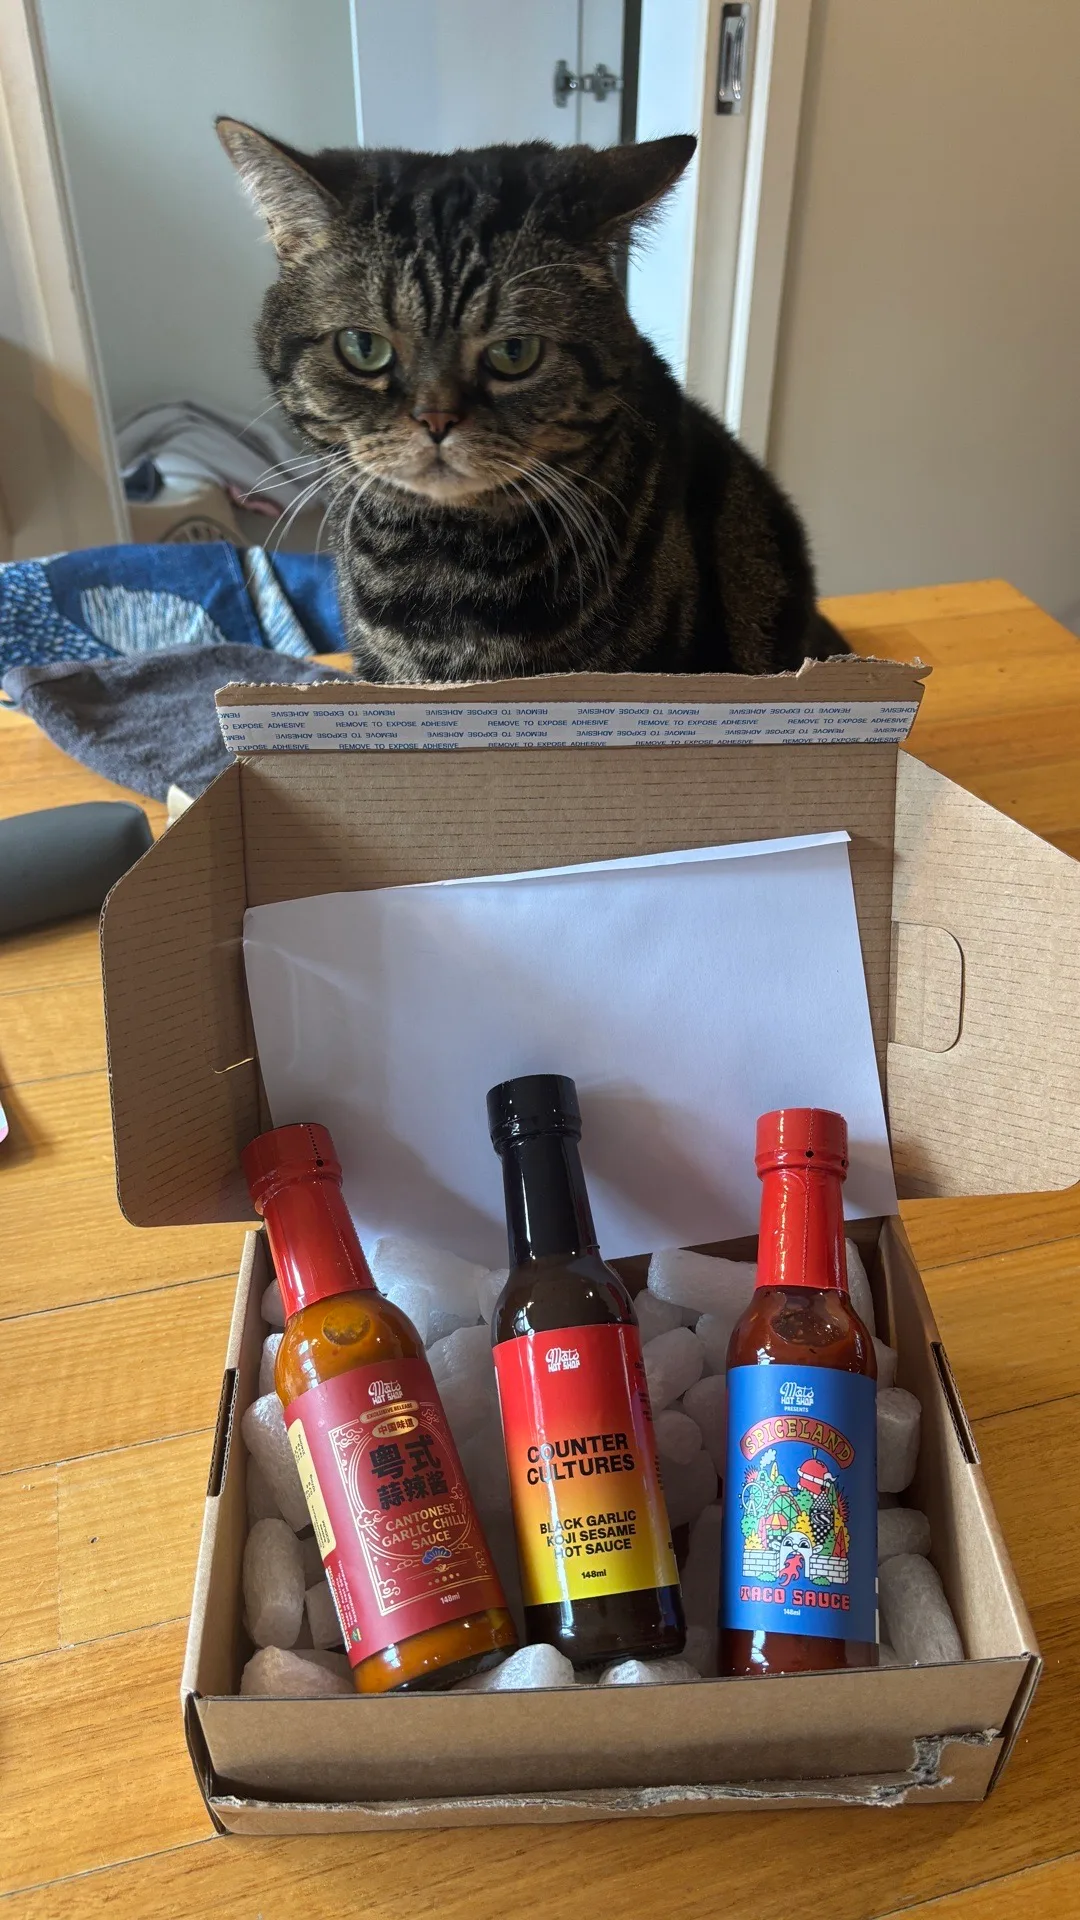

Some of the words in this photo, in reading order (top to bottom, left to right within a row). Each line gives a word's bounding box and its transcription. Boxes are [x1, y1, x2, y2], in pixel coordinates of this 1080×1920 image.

[548, 1363, 561, 1372] HOT
[563, 1360, 580, 1370] SHOP
[372, 1394, 386, 1405] HOT
[386, 1390, 403, 1400] SHOP
[796, 1398, 814, 1406] SHOP
[366, 1407, 393, 1419] EXCLUSIVE
[394, 1403, 412, 1411] RELEASE
[378, 1418, 414, 1434] 中国味道
[527, 1433, 628, 1464] COUNTER
[744, 1418, 851, 1461] SPICELAND
[369, 1434, 442, 1480] 粤式
[526, 1454, 635, 1485] CULTURES
[377, 1470, 448, 1510] 蒜辣酱
[386, 1503, 456, 1531] CANTONESE
[540, 1518, 582, 1534] BLACK
[586, 1510, 636, 1527] GARLIC
[382, 1522, 430, 1547] GARLIC
[432, 1514, 466, 1529] CHILLI
[412, 1530, 451, 1550] SAUCE
[546, 1534, 576, 1547] KOJI
[580, 1524, 636, 1542] SESAME
[554, 1546, 581, 1559] HOT
[586, 1538, 631, 1555] SAUCE
[581, 1569, 606, 1579] 148ml
[440, 1592, 460, 1604] 148ml
[740, 1586, 786, 1604] TACO
[792, 1589, 850, 1610] SAUCE
